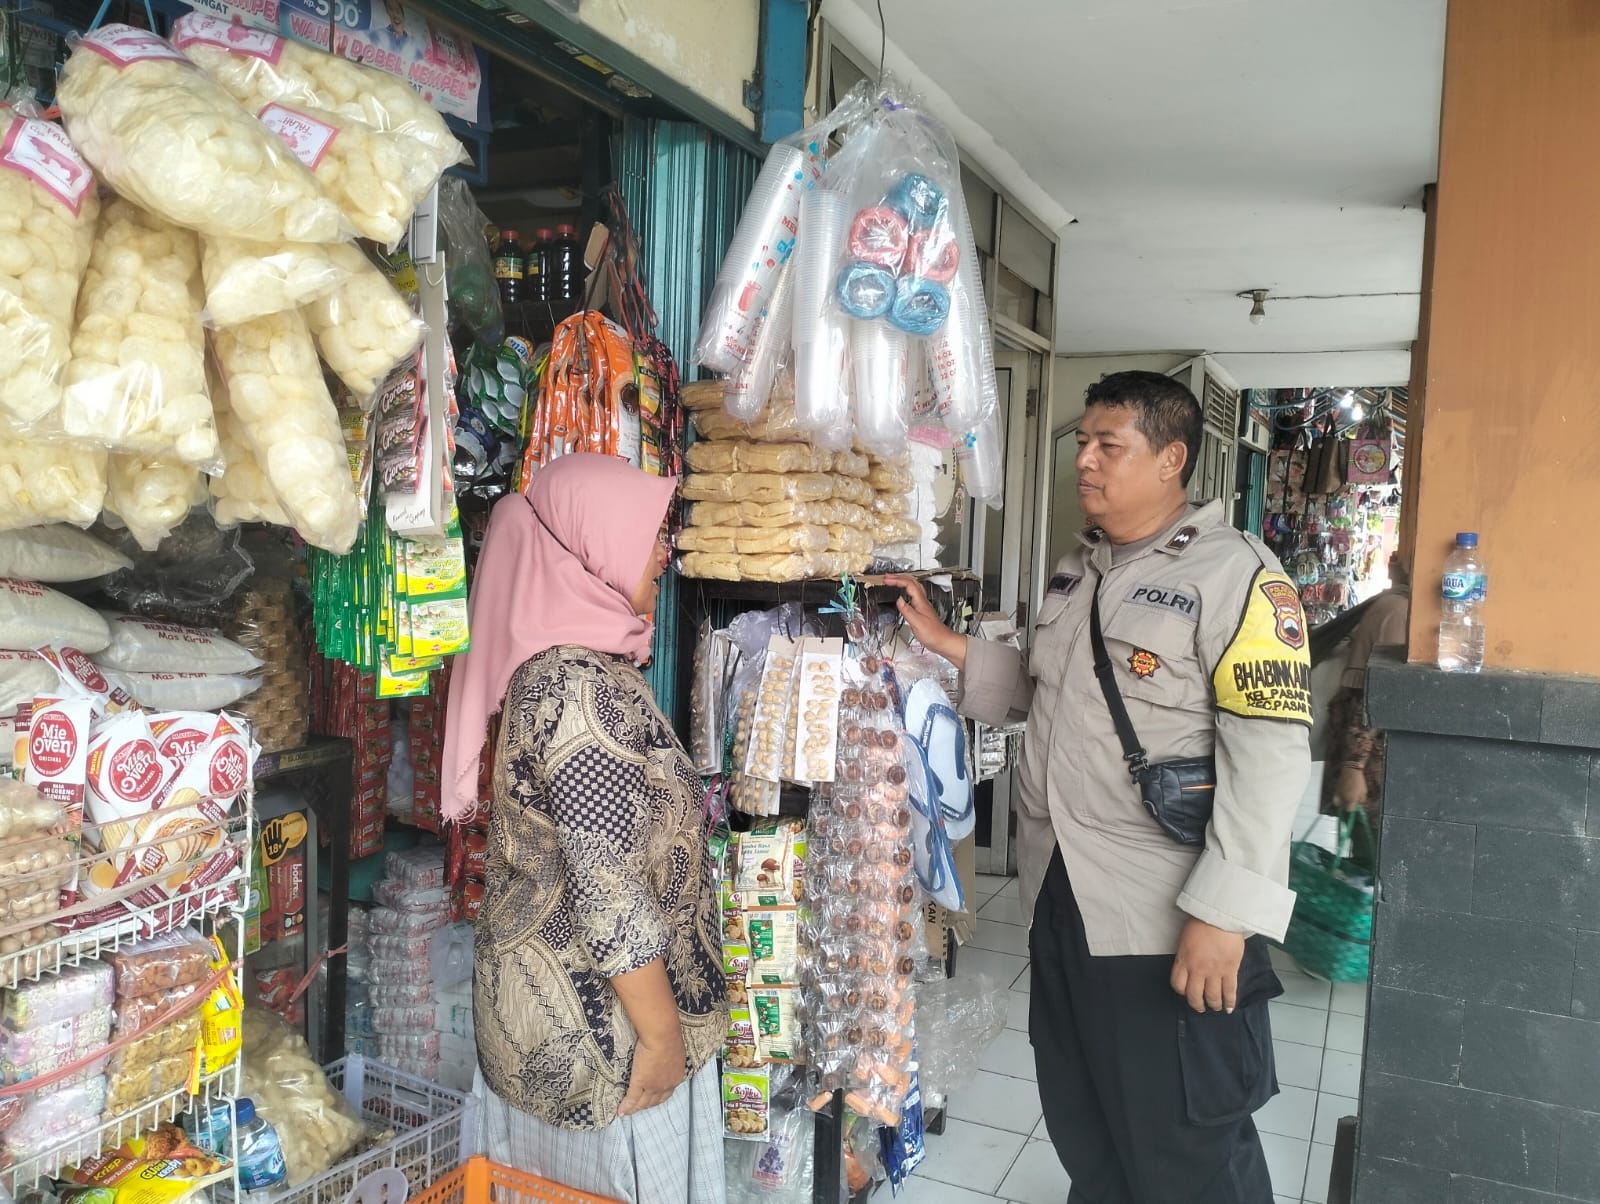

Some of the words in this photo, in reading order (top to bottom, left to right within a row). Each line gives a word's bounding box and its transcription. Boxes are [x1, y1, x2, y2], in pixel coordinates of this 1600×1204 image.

[1131, 588, 1195, 614] POLRI
[40, 721, 67, 740] Mie
[32, 737, 75, 758] Oven
[227, 746, 243, 774] Mie
[117, 749, 145, 777] Mie
[120, 752, 156, 794] Oven
[215, 756, 242, 790] Oven
